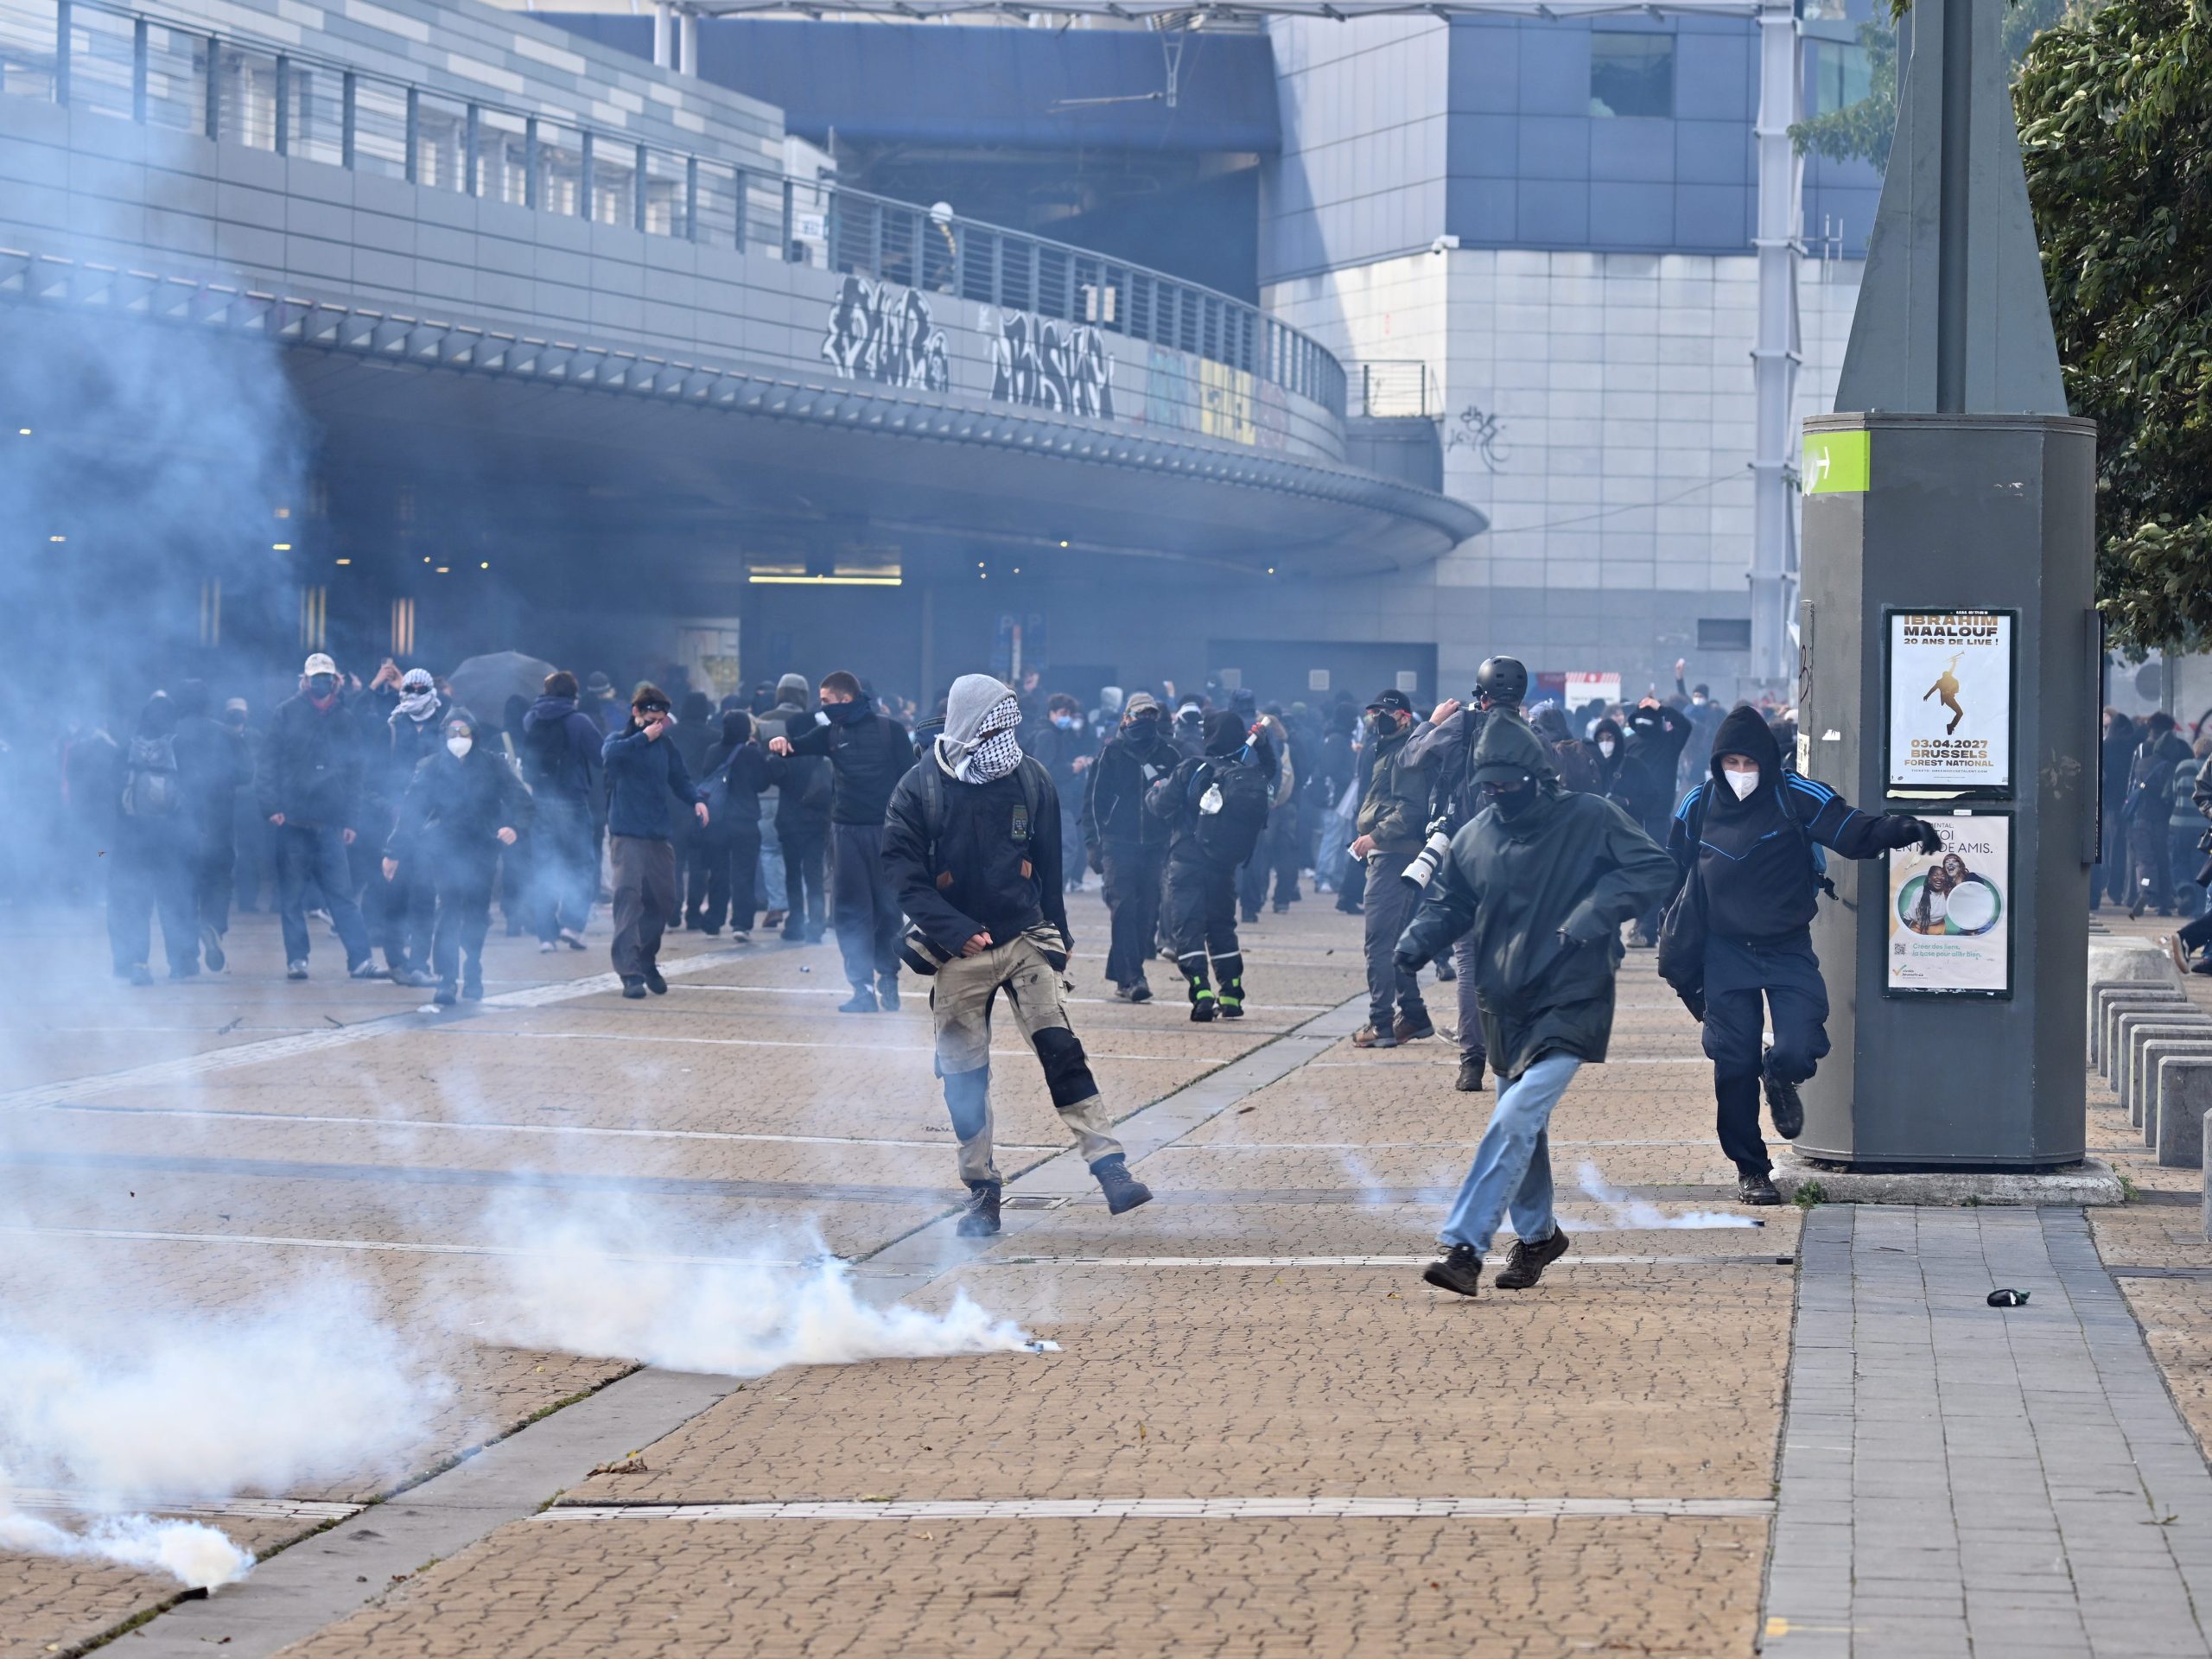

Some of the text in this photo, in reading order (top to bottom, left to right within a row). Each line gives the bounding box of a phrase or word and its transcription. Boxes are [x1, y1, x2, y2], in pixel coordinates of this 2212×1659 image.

[1904, 614, 1998, 626] IBRAHIM
[1904, 626, 1998, 637] MAALOUF
[1910, 739, 1988, 748] 03.04.2027
[1910, 749, 1988, 759] BRUSSELS
[1916, 842, 1955, 853] MDE
[1957, 842, 1993, 854] AMIS.
